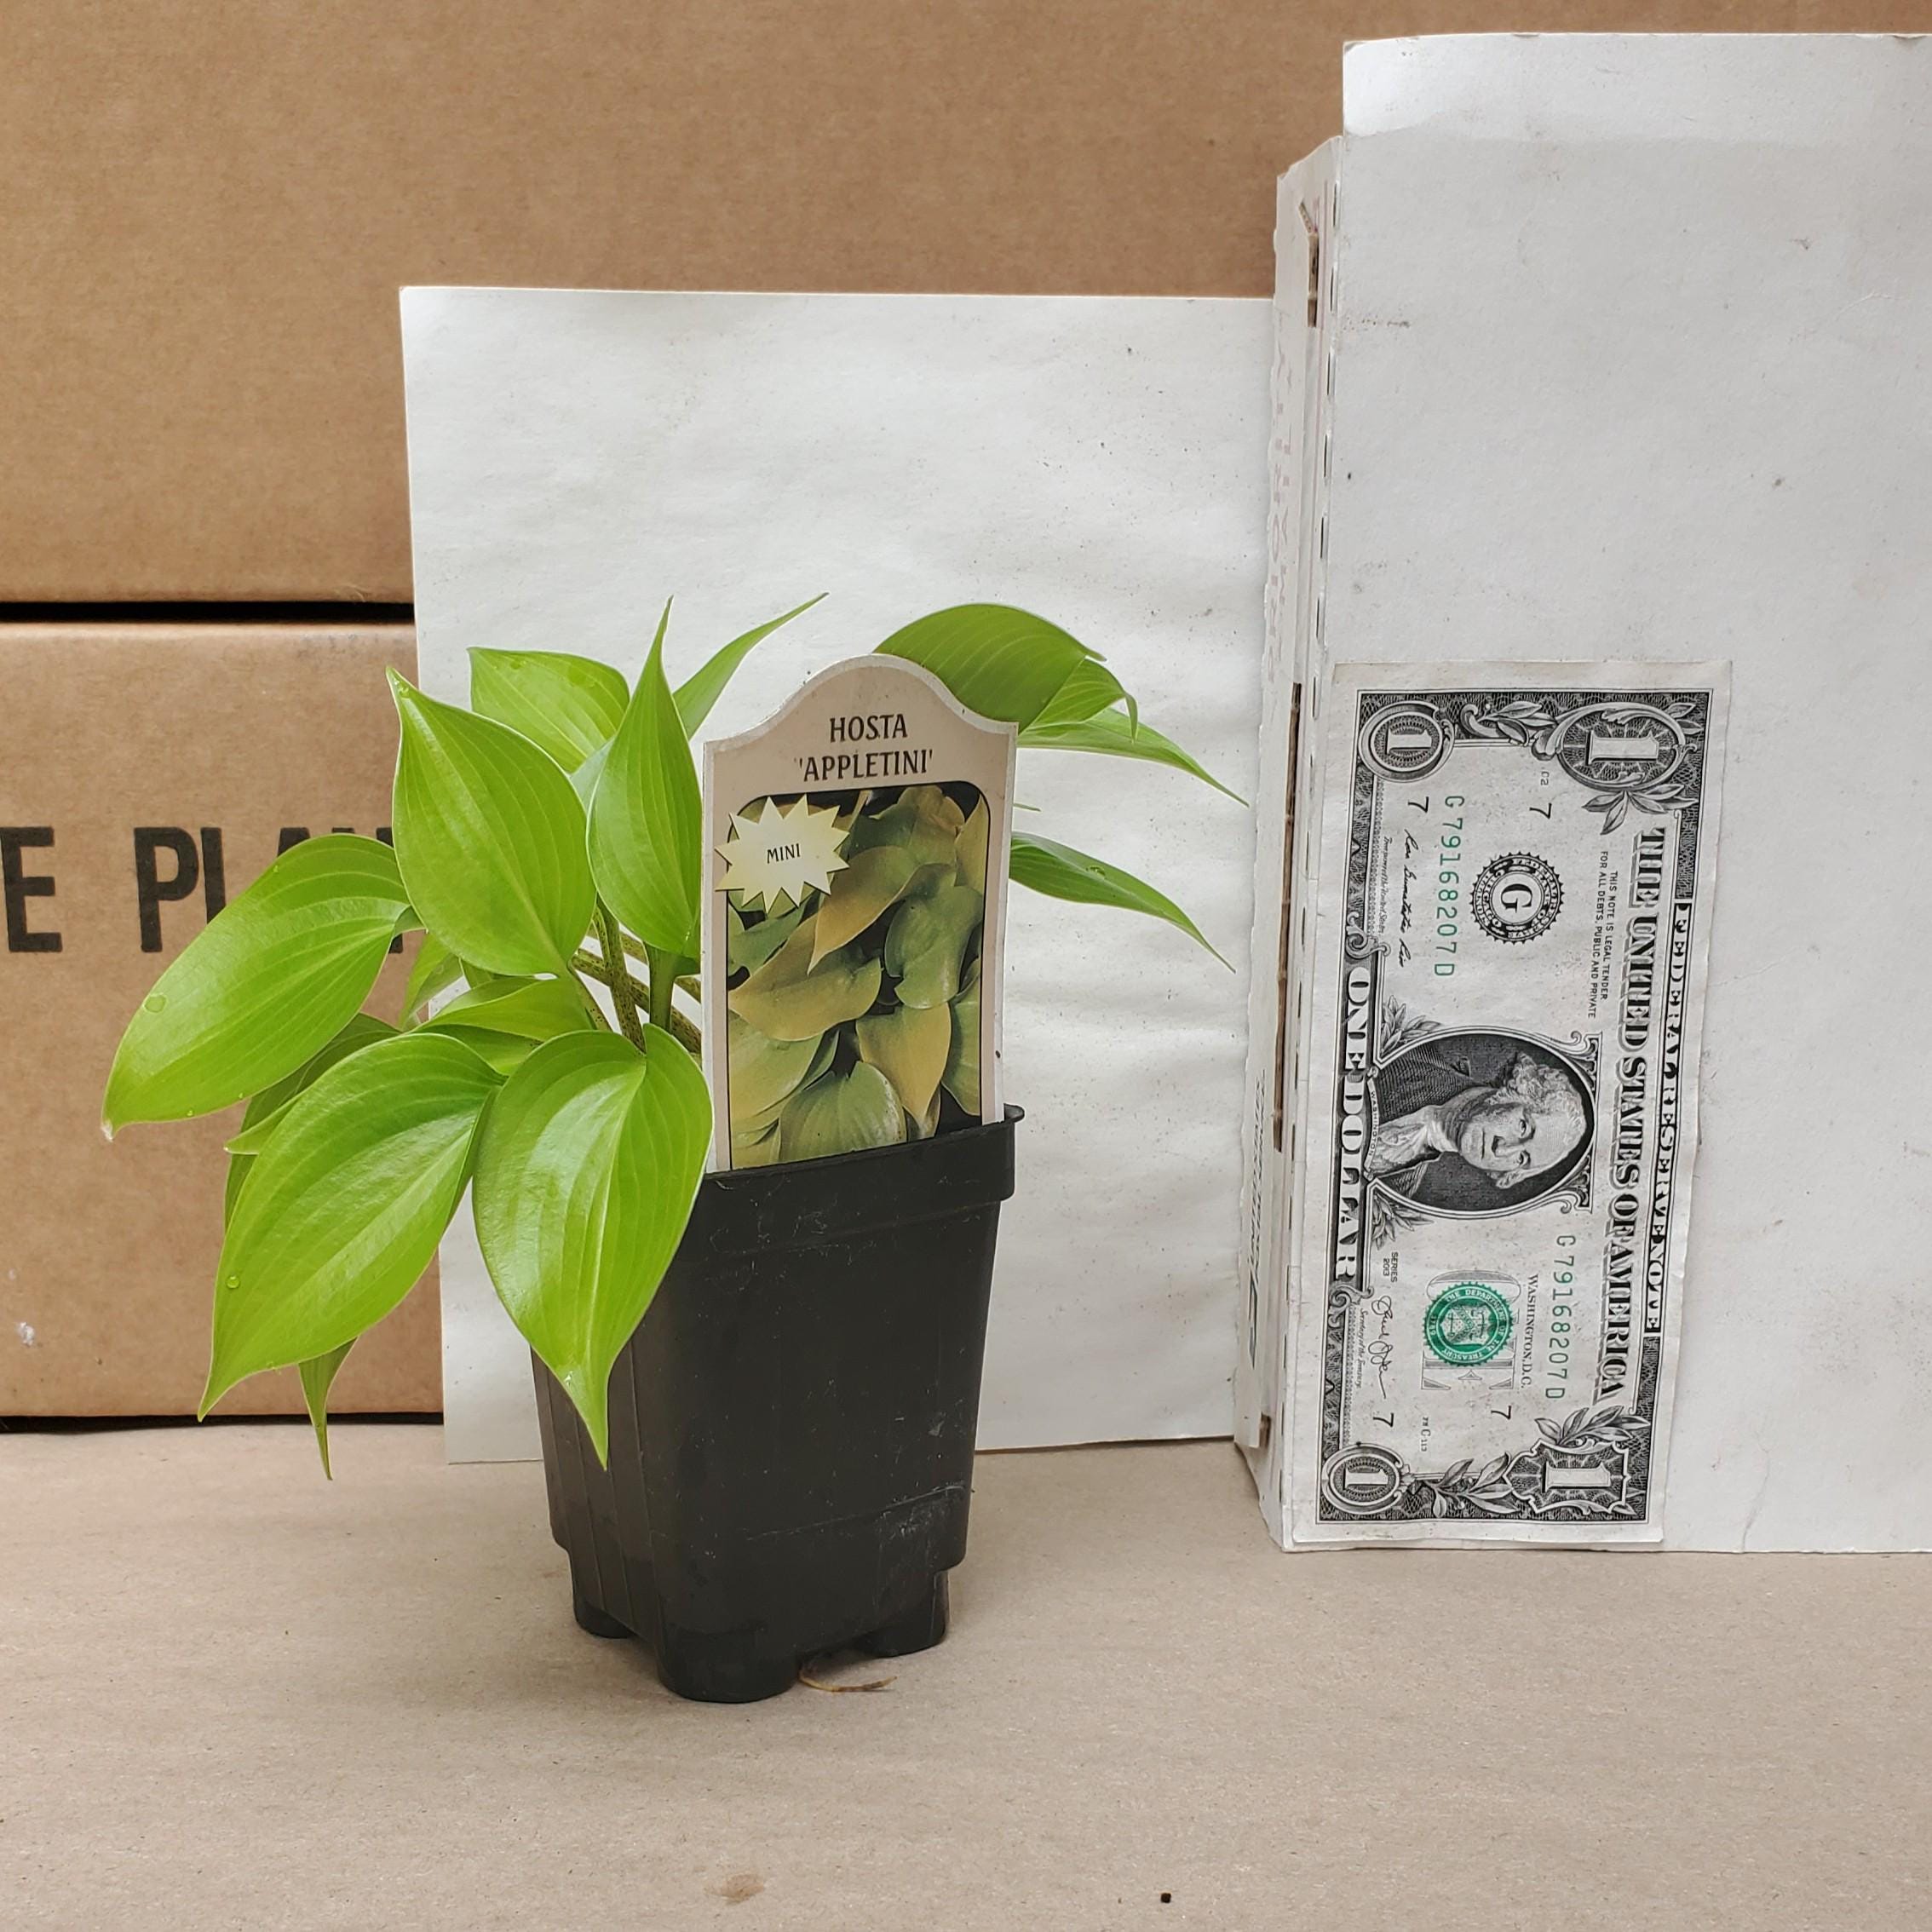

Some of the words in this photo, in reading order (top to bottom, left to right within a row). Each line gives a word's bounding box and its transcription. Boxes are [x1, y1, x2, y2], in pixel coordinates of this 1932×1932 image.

[830, 713, 908, 743] HOSTA
[1407, 796, 1429, 814] 7
[1528, 802, 1552, 819] 7
[767, 843, 801, 864] MINI
[1599, 851, 1608, 868] FOR
[1628, 828, 1666, 908] THE
[1597, 871, 1607, 888] ALL
[1608, 871, 1619, 891] THIS
[1499, 884, 1533, 913] G
[1606, 896, 1615, 918] NOTE
[1591, 927, 1602, 957] PUBLIC
[1605, 923, 1613, 932] IS
[1601, 935, 1613, 962] LEGAL
[1590, 961, 1600, 979] AND
[1600, 964, 1610, 1000] TENDER
[1615, 912, 1658, 1051] UNITED
[1587, 983, 1598, 1019] PRIVATE
[1663, 906, 1690, 1072] FEDERAL
[1344, 968, 1370, 1070] ONE
[1368, 1090, 1379, 1156] WASHINGTON
[1608, 1056, 1647, 1188] STATES
[1651, 1078, 1676, 1235] RESERVE
[1335, 1077, 1365, 1281] DOLLAR
[1605, 1194, 1639, 1238] OF
[1382, 1258, 1390, 1276] 2013
[1646, 1239, 1665, 1329] NOTE
[1592, 1242, 1632, 1406] AMERICA
[1371, 1412, 1394, 1428] 7
[1490, 1406, 1511, 1419] 7
